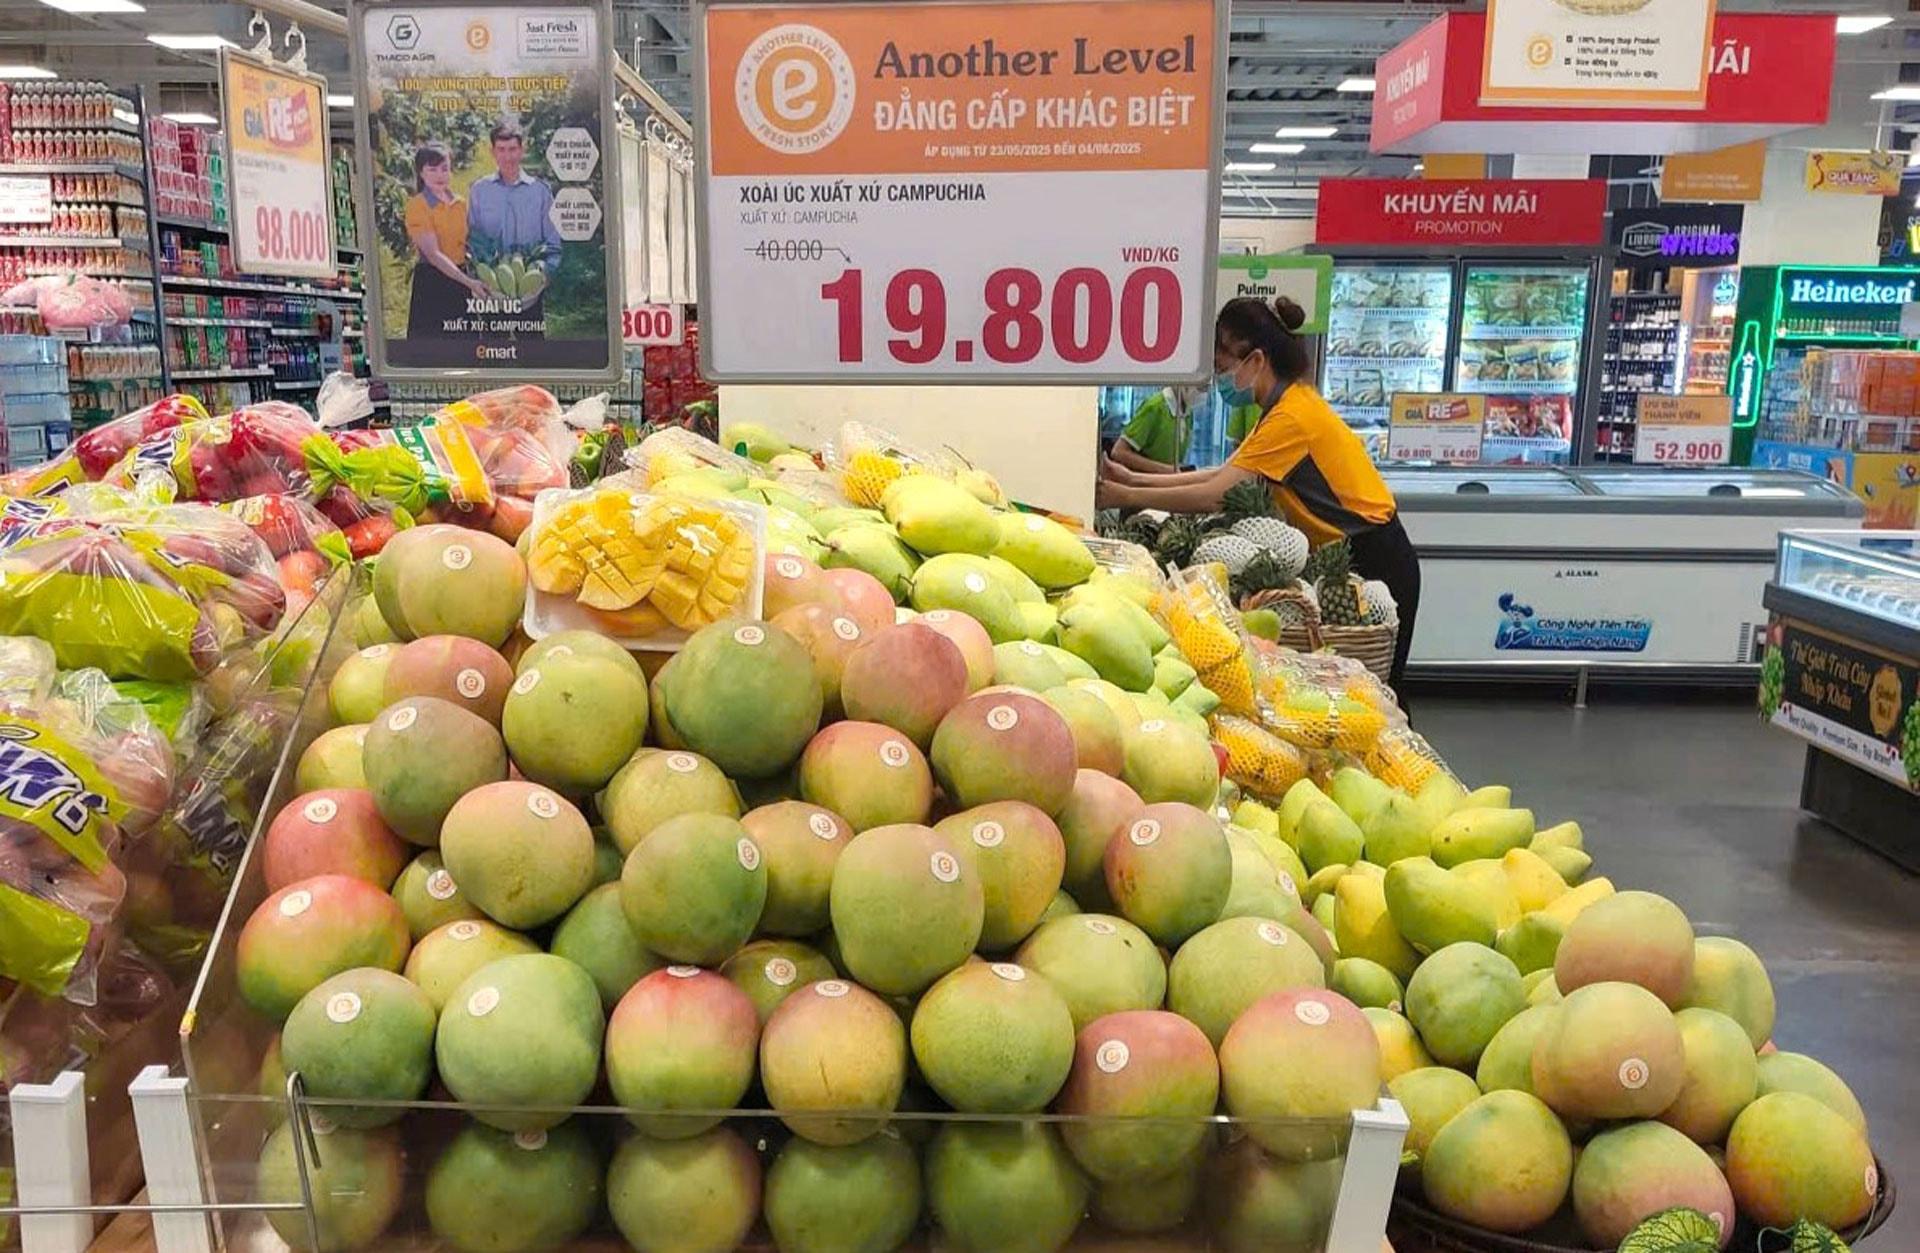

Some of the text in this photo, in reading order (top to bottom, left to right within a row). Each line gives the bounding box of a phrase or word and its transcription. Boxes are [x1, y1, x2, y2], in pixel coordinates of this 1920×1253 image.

[547, 20, 577, 33] Fresh
[874, 34, 1197, 79] Another Level
[1708, 38, 1750, 75] ÃI
[873, 86, 1196, 134] ĐẲNG CẤP KHÁC BIỆT
[798, 122, 834, 148] STORY
[740, 180, 987, 203] XOÀI ÚC XUẤT XỨ CAMPUCHIA
[1384, 187, 1538, 214] KHUYẾN MÃI
[740, 209, 769, 225] XUẤT
[793, 210, 859, 224] CAMPUCHIA
[1414, 219, 1503, 235] PROMOTION
[256, 205, 326, 261] 98.000
[755, 239, 823, 261] 40.000
[1122, 246, 1180, 264] VND/KG
[1237, 282, 1277, 296] Pulmu
[1790, 279, 1912, 305] Heineken
[820, 265, 1184, 364] 19.800
[490, 320, 546, 332] CAMPUCHIA
[476, 345, 518, 359] emart
[1654, 442, 1723, 461] 52.900
